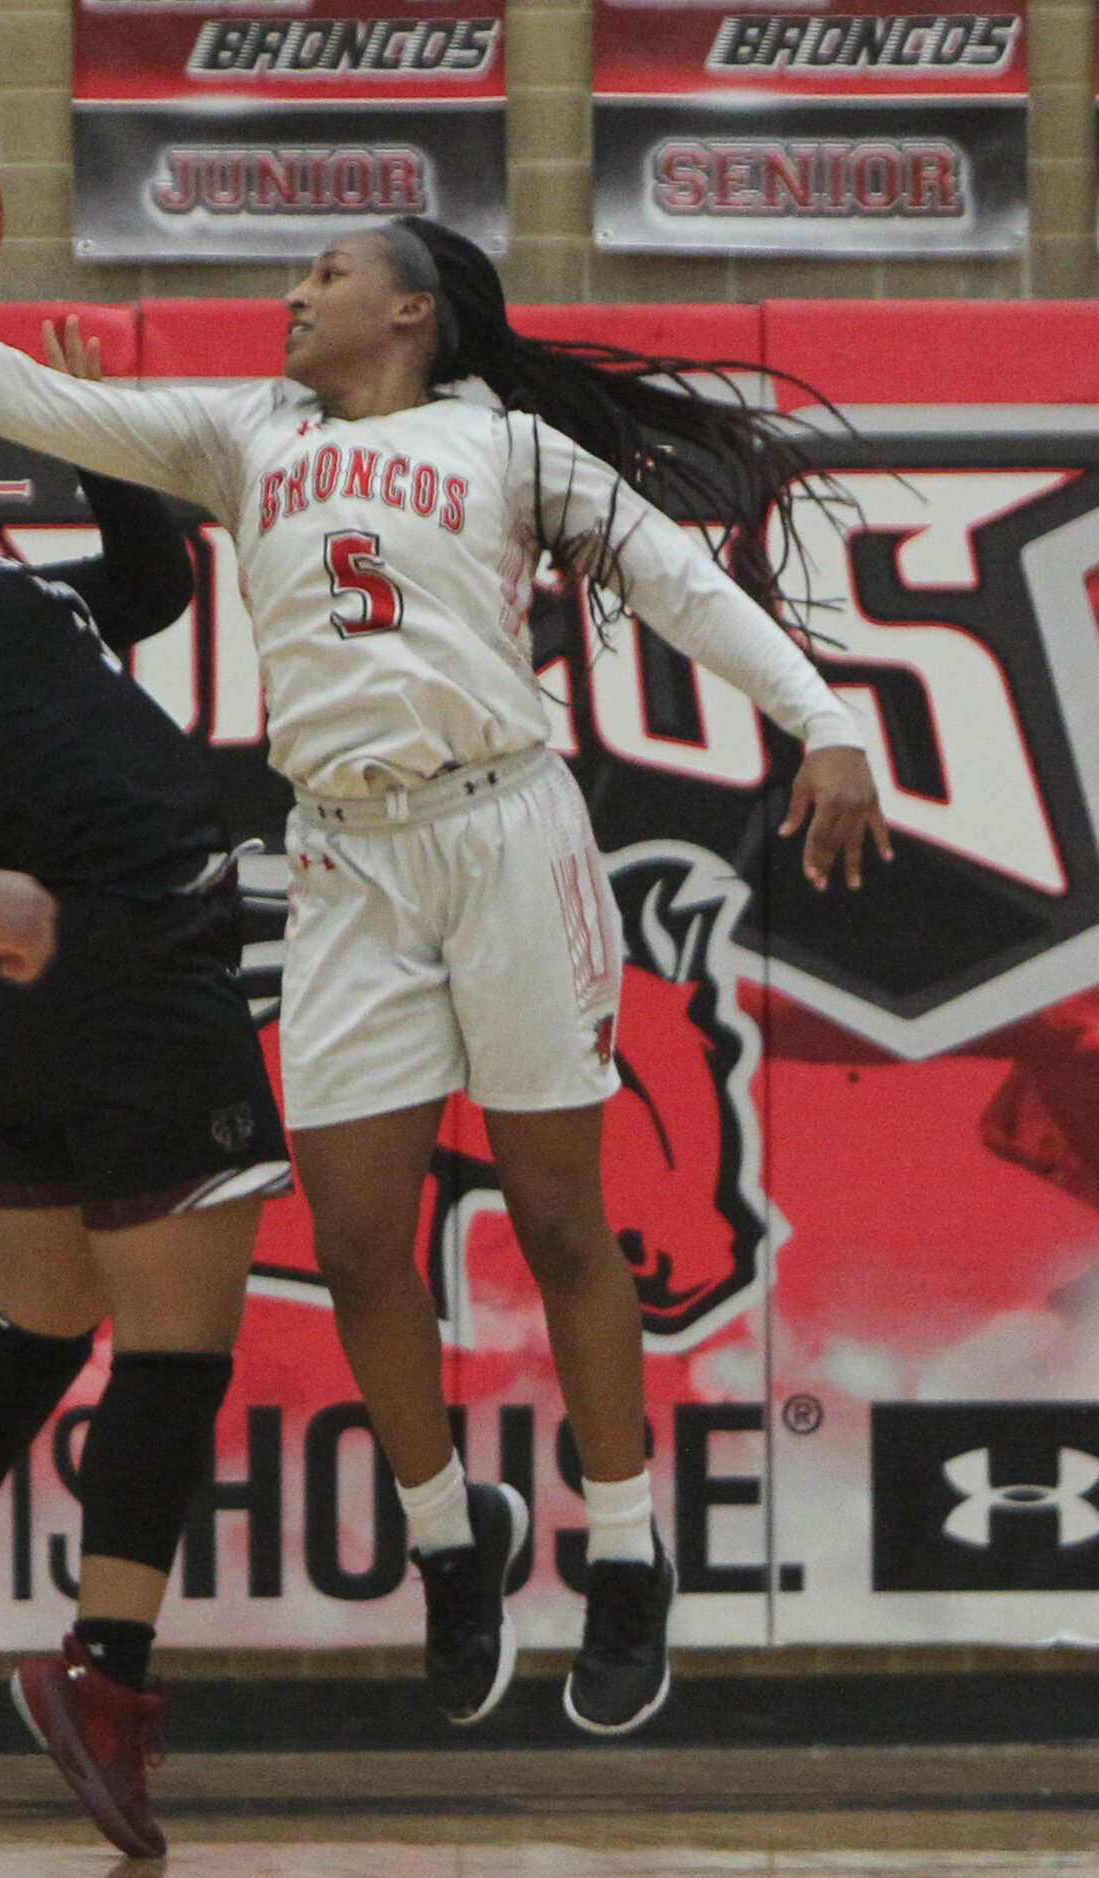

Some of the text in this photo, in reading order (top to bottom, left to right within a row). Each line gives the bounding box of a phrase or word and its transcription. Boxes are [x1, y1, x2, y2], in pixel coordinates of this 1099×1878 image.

[187, 18, 501, 78] BRONCOS
[706, 13, 1022, 74] BRONCOS
[151, 144, 428, 215] JUNIOR
[656, 138, 969, 218] SENIOR
[259, 443, 468, 535] BRONCOS
[323, 528, 404, 640] 5
